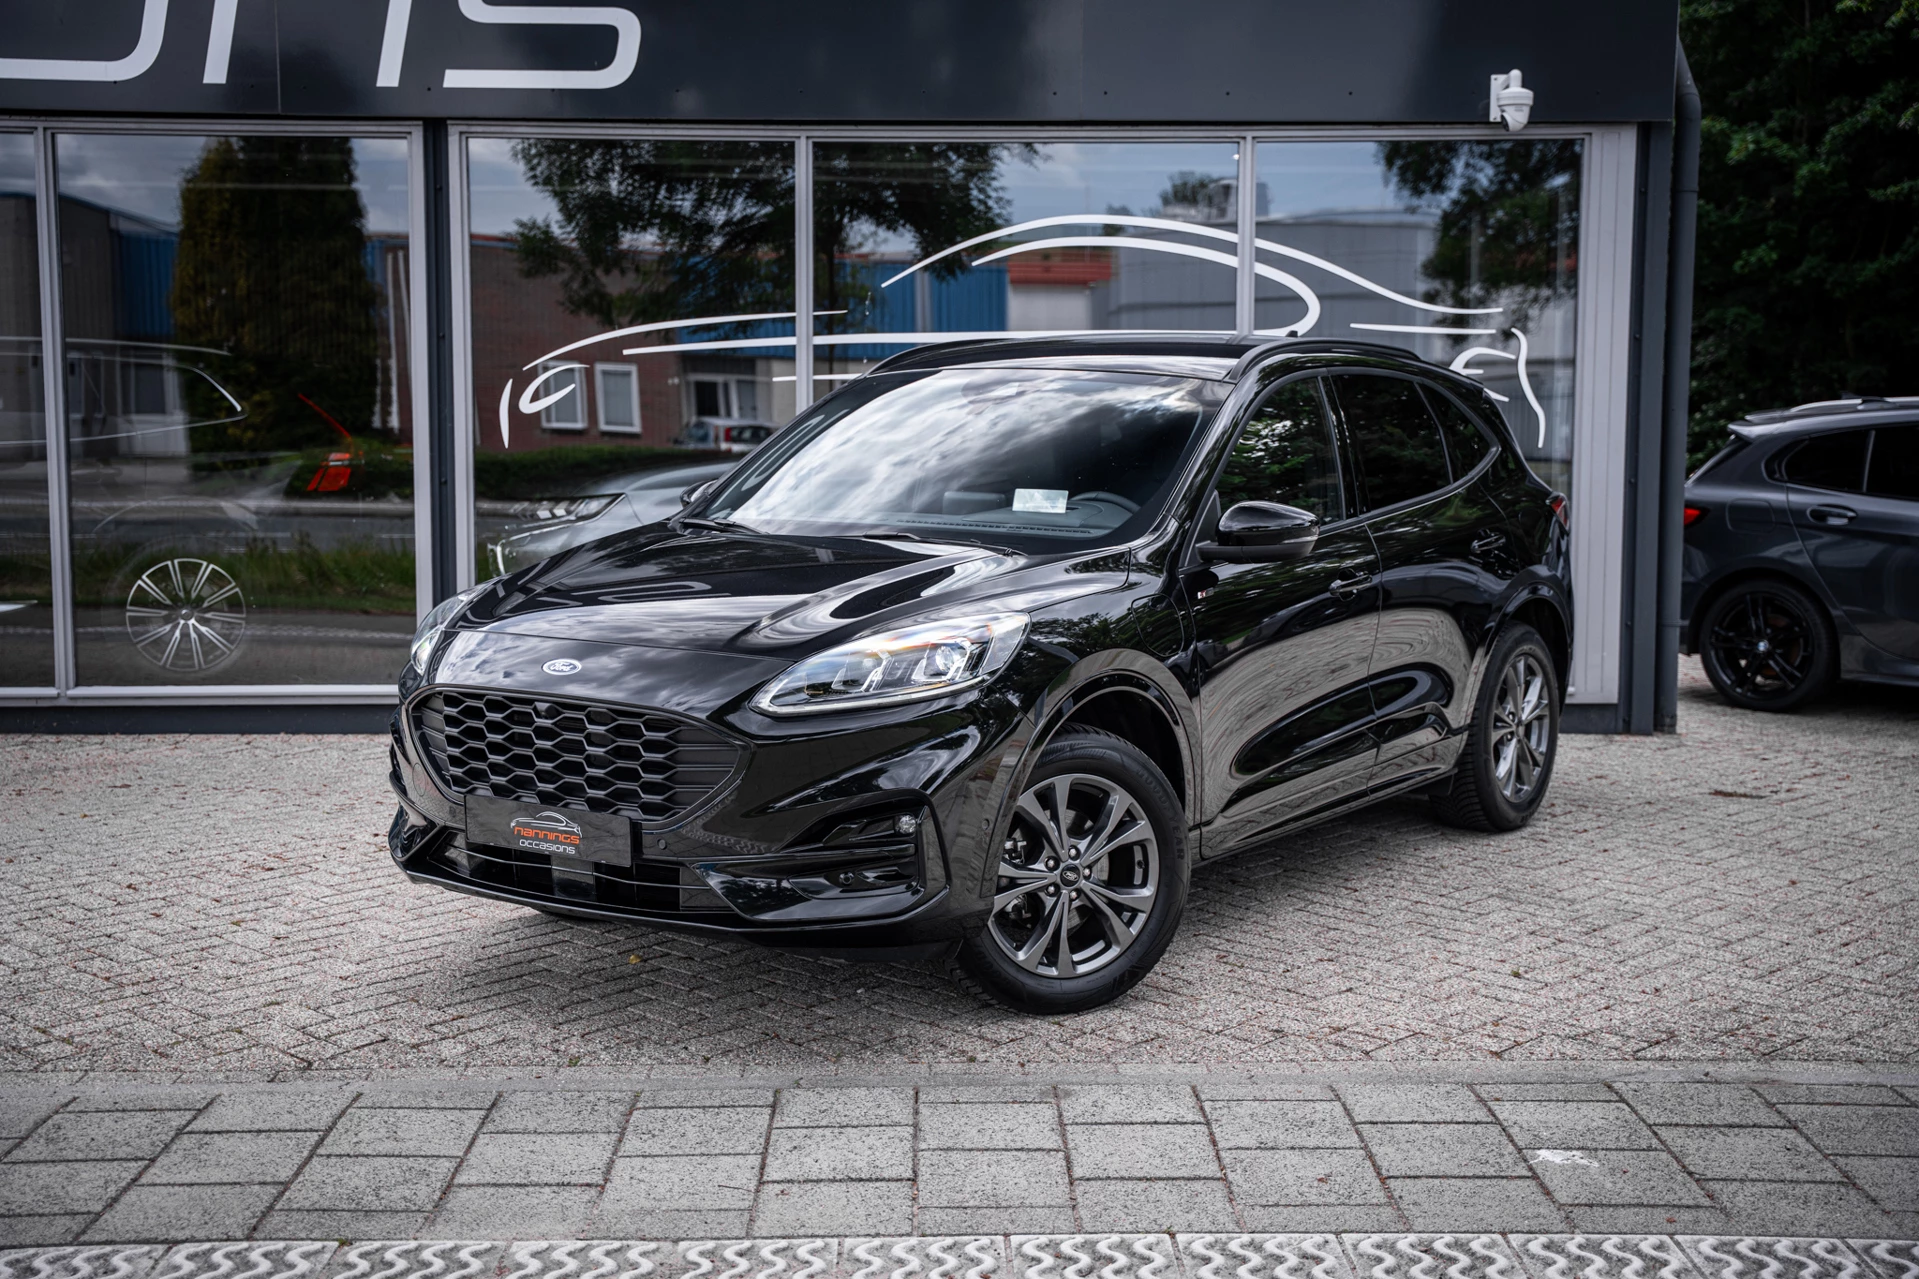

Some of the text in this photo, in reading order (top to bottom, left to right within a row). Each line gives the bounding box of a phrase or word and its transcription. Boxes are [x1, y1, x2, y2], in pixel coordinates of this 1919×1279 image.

[548, 660, 577, 672] Ford
[514, 826, 580, 845] nannings
[519, 838, 576, 855] occasions
